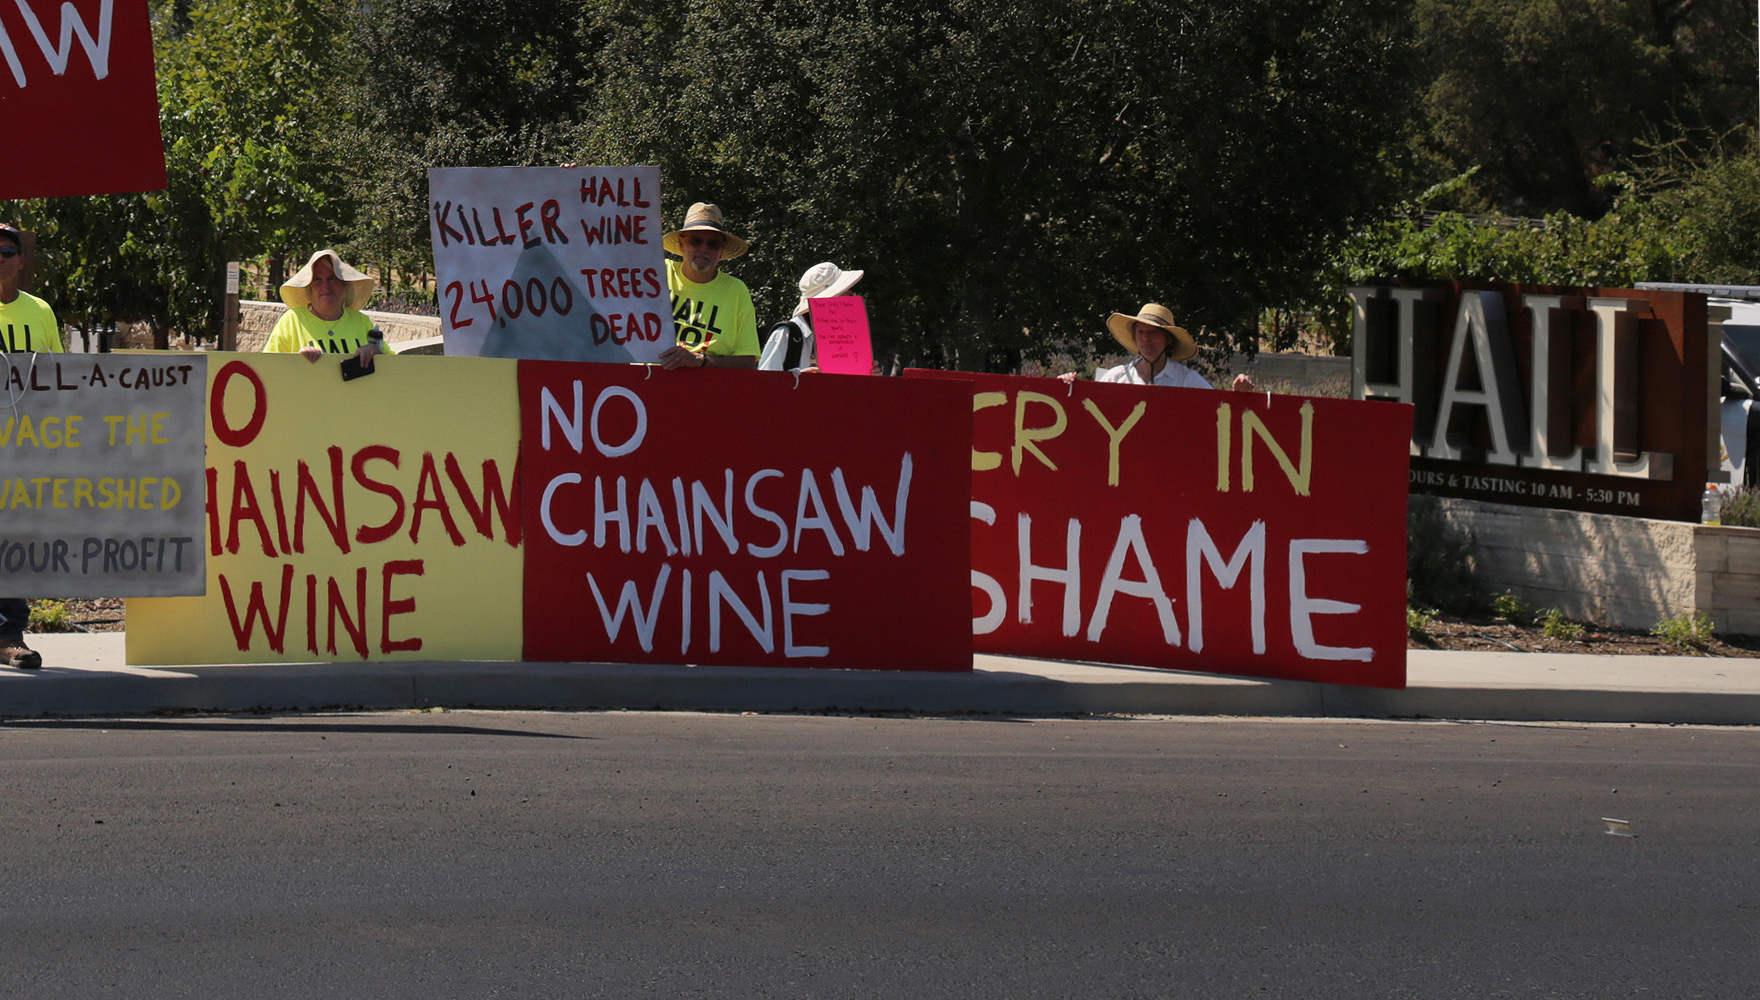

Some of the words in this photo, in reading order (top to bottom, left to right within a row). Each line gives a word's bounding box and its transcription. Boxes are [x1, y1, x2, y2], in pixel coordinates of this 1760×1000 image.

[580, 176, 650, 209] HALL
[433, 199, 569, 250] KILLER
[580, 214, 648, 247] WINE
[580, 267, 661, 299] TREES
[590, 312, 662, 347] DEAD
[1346, 286, 1650, 480] HALL
[103, 412, 170, 447] THE
[541, 379, 648, 459] NO
[1216, 400, 1315, 496] IN
[539, 451, 914, 559] CHAINSAW
[1409, 469, 1444, 487] OURS
[1448, 474, 1458, 488] &
[1463, 475, 1526, 494] TASTING
[1531, 482, 1546, 496] 10
[1548, 484, 1573, 499] AM
[1586, 490, 1614, 504] 5:30
[1617, 491, 1641, 507] PM
[81, 536, 192, 575] PROFIT
[219, 559, 425, 660] WINE
[586, 562, 831, 658] WINE
